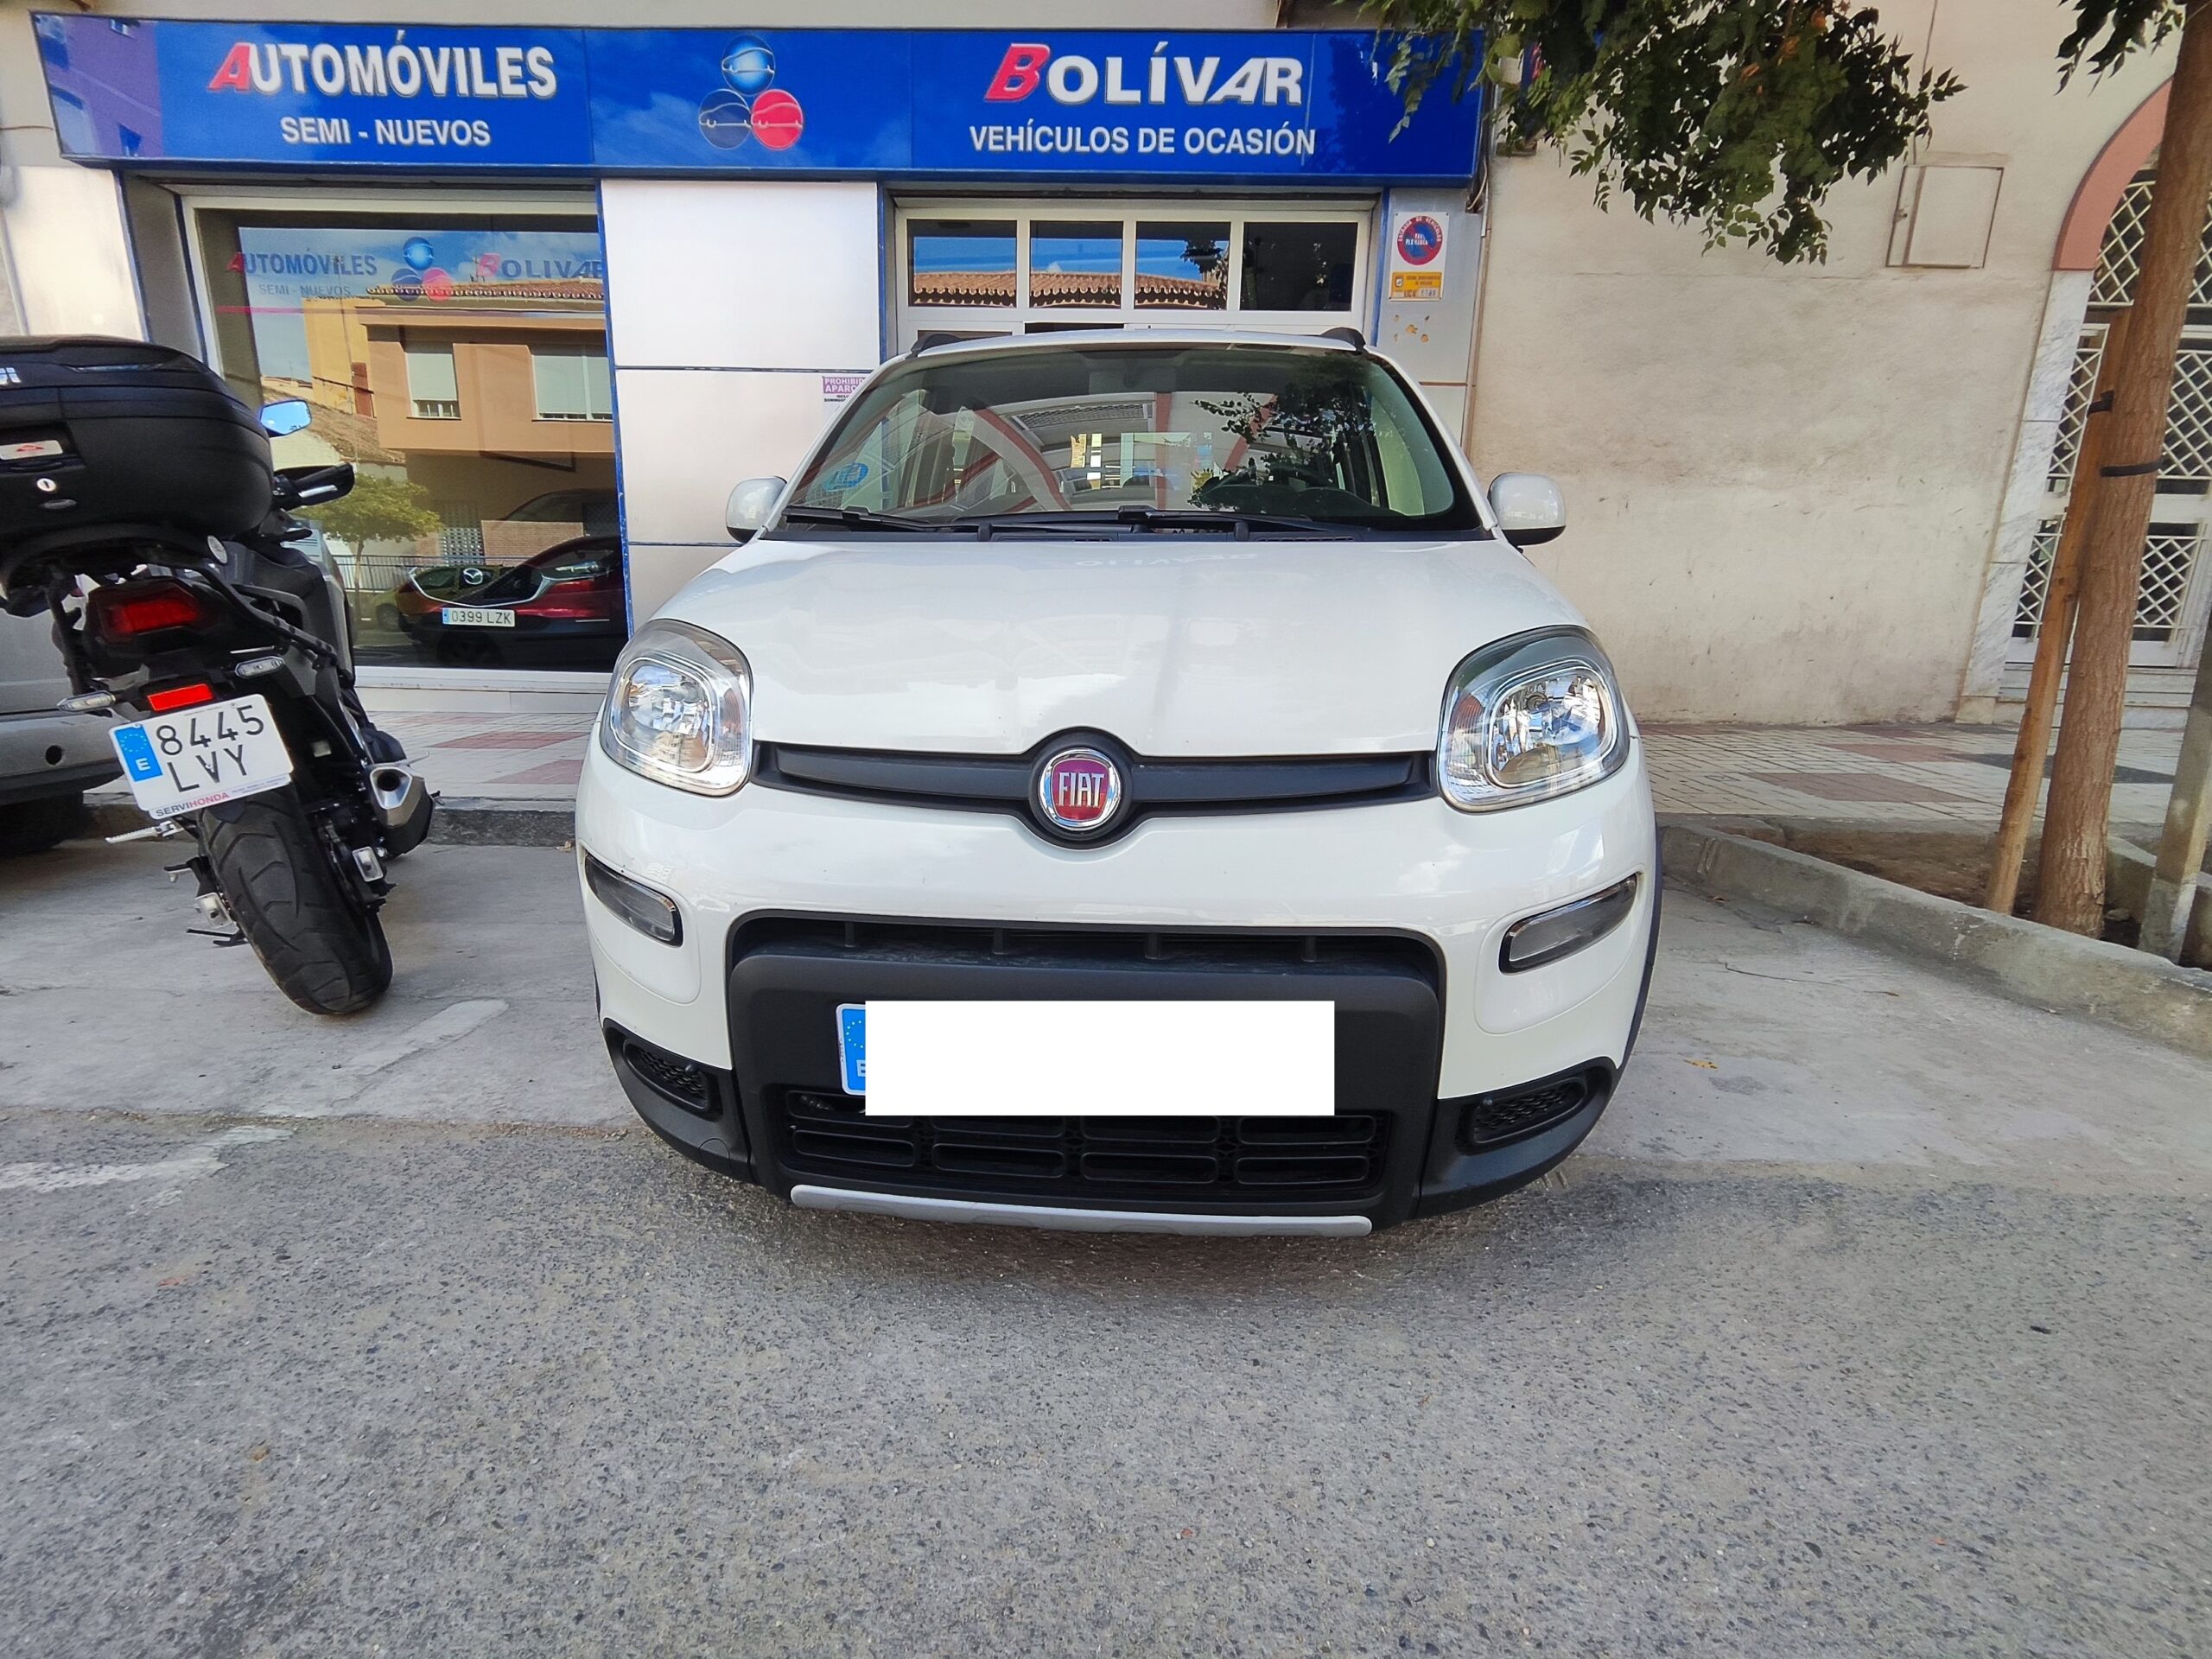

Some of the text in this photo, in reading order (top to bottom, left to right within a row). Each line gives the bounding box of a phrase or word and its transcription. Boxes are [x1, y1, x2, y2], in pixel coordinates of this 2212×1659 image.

[207, 30, 557, 97] AUTOMÓVILES
[983, 41, 1303, 105] BOLÍVAR
[280, 117, 351, 145] SEMI
[375, 118, 492, 147] NUEVOS
[969, 118, 1316, 155] VEHÍCULOS DE OCASIÓN
[226, 247, 378, 276] AUTOMÓVILES
[259, 284, 289, 296] SEMI
[300, 285, 352, 296] NUEVOS
[452, 610, 512, 624] 0399 LZK
[156, 704, 264, 755] 8445
[136, 758, 151, 772] E
[167, 744, 248, 792] LVY
[156, 791, 230, 817] SERVIHONDA
[1058, 772, 1105, 808] FIAT
